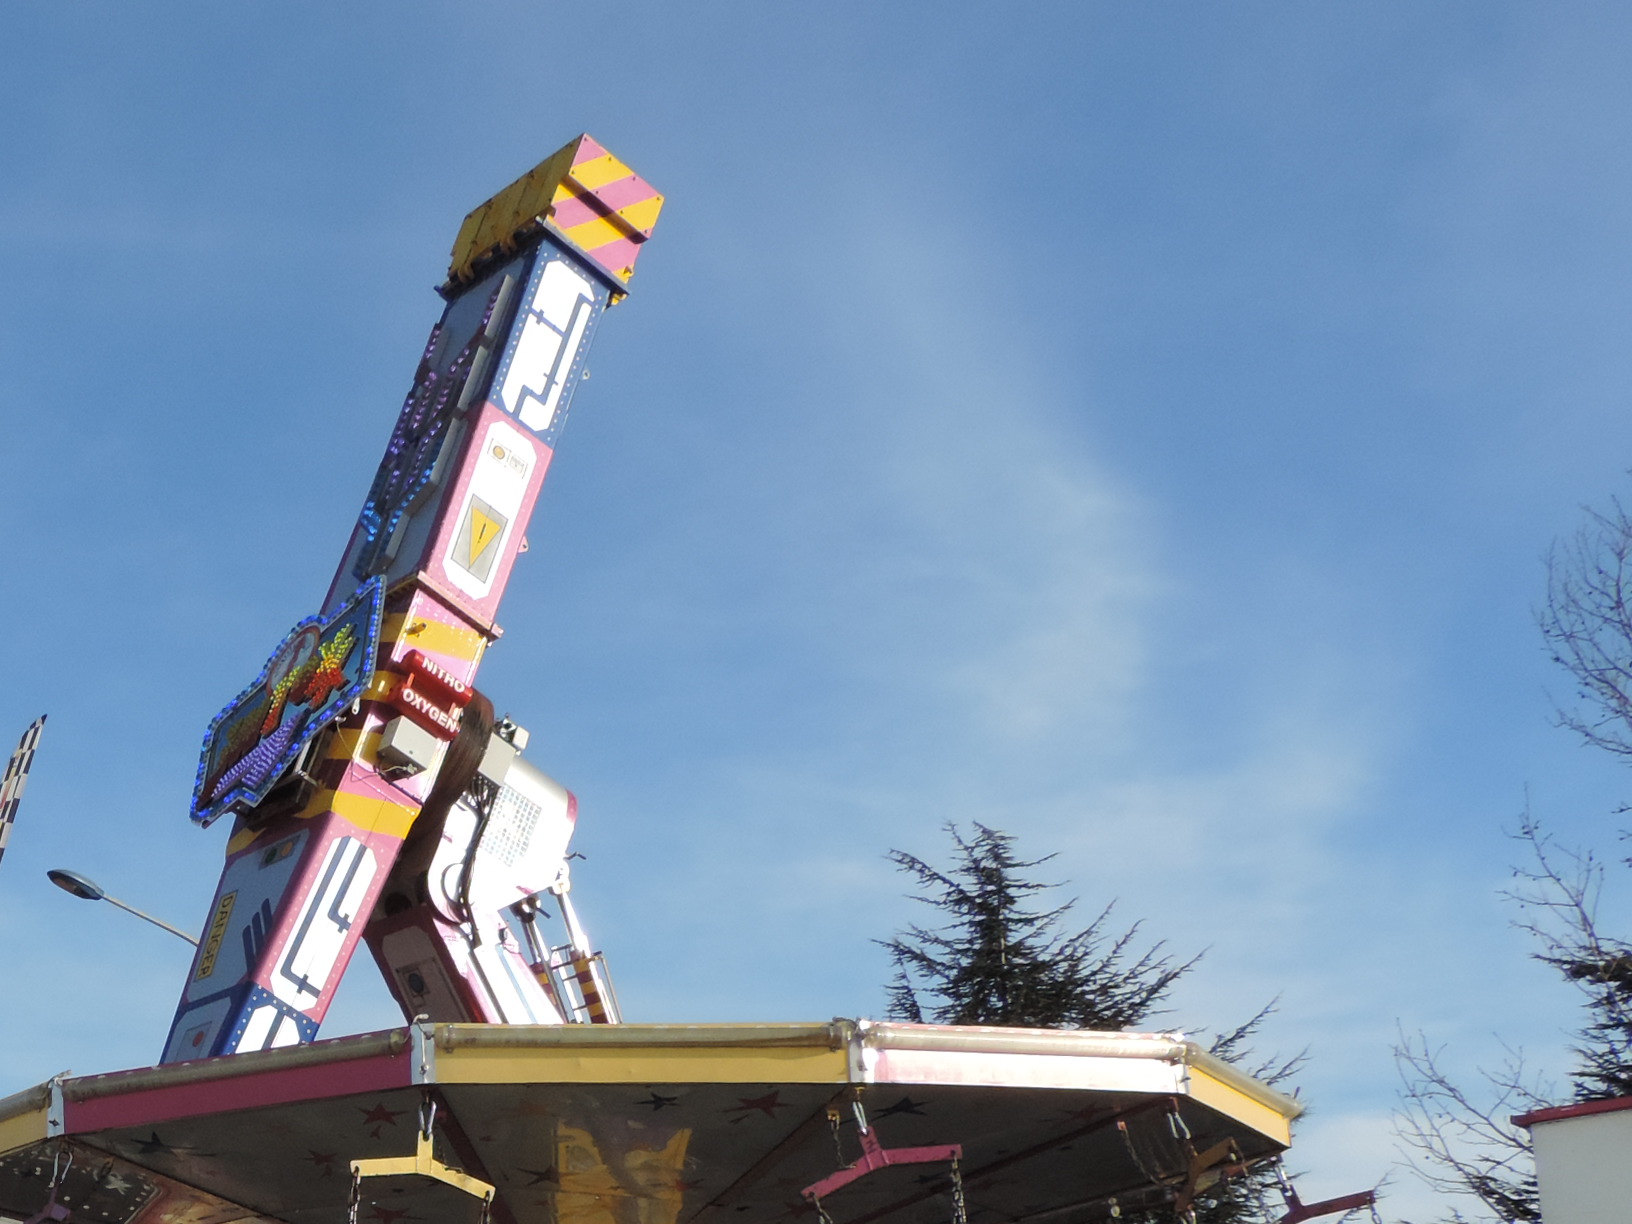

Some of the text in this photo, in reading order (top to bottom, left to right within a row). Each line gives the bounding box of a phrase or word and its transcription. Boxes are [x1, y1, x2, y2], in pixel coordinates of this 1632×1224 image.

[422, 657, 465, 693] NITRO
[402, 688, 457, 733] OXYGEN
[198, 894, 235, 978] DANGER
